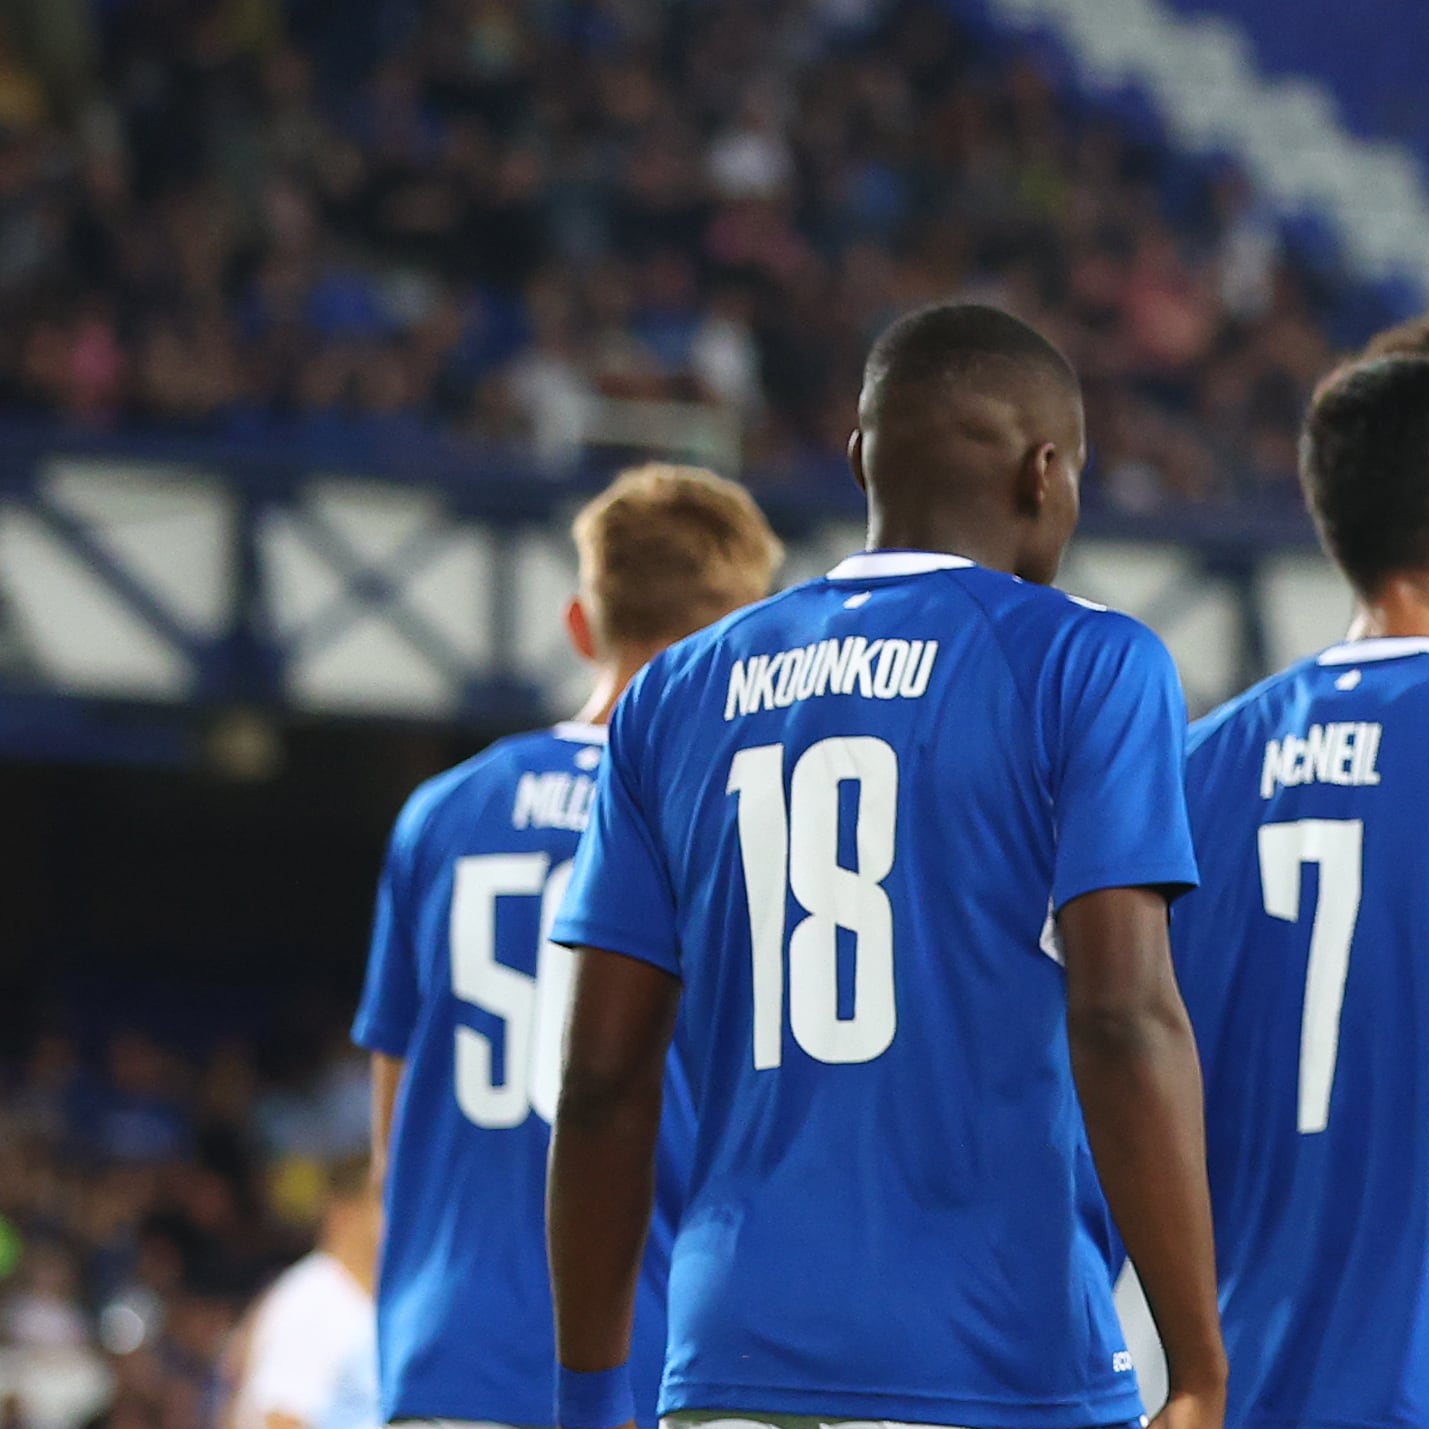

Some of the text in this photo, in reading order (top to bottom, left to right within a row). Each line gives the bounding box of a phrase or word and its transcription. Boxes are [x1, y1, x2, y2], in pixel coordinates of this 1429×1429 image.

[723, 636, 939, 721] NKOUNKOU
[725, 735, 898, 1071] 18
[1258, 818, 1363, 1134] 7
